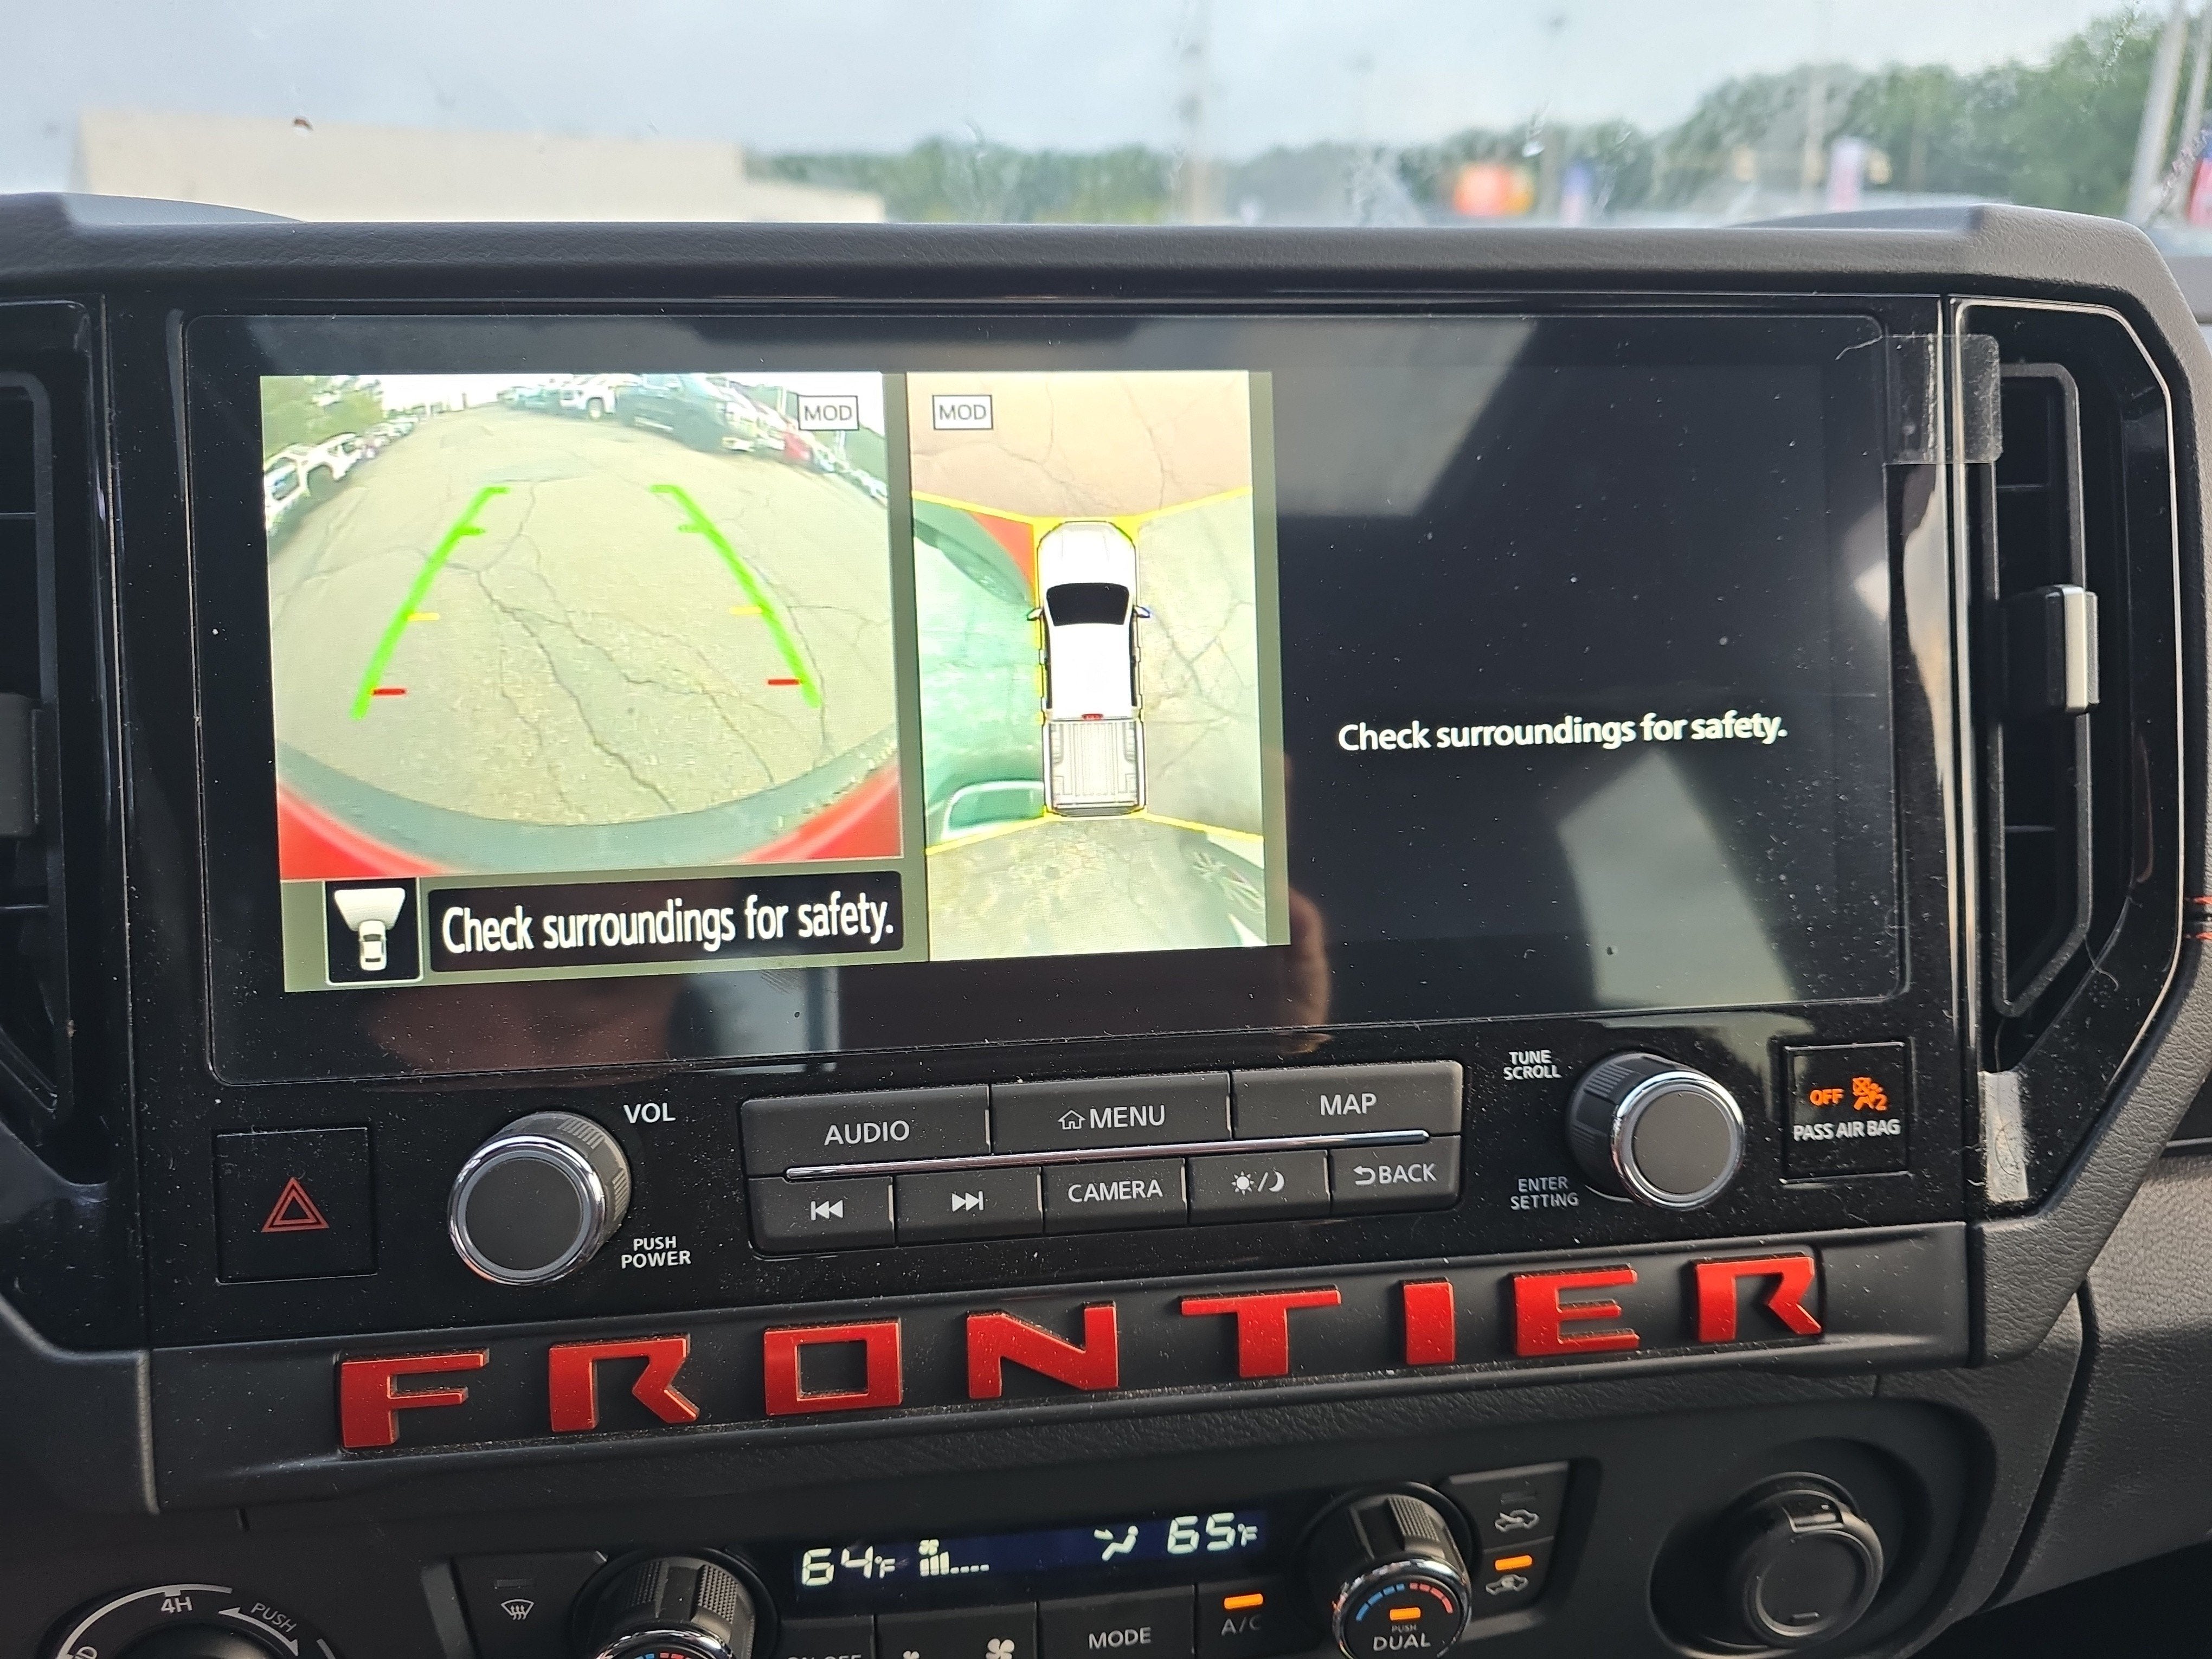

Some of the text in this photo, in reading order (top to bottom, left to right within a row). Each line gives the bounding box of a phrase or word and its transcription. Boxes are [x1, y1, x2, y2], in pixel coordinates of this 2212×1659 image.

[803, 404, 853, 421] MOD
[938, 403, 987, 420] MOD
[1338, 710, 1789, 751] Check surroundings for safety.
[441, 891, 895, 954] Check surroundings for safety.
[1508, 1049, 1552, 1065] TUNE
[1503, 1061, 1562, 1081] SCROLL
[1320, 1092, 1378, 1116] MAP
[1809, 1088, 1844, 1107] OFF
[623, 1102, 677, 1124] VOL
[1089, 1104, 1166, 1130] MENU
[824, 1120, 911, 1146] AUDIO
[1793, 1118, 1901, 1142] PASS AIR BAG
[1379, 1162, 1438, 1185] BACK
[1517, 1176, 1569, 1192] ENTER
[1067, 1179, 1164, 1203] CAMERA
[1509, 1192, 1580, 1211] SETTING
[632, 1235, 677, 1251] PUSH
[621, 1250, 692, 1269] POWER
[338, 1253, 1823, 1449] FRONTIER
[160, 1596, 193, 1613] 4H
[250, 1602, 297, 1634] PUSH
[1220, 1614, 1262, 1636] A/C
[1391, 1624, 1417, 1633] PUSH
[1088, 1626, 1153, 1651] MODE
[1373, 1632, 1432, 1651] DUAL
